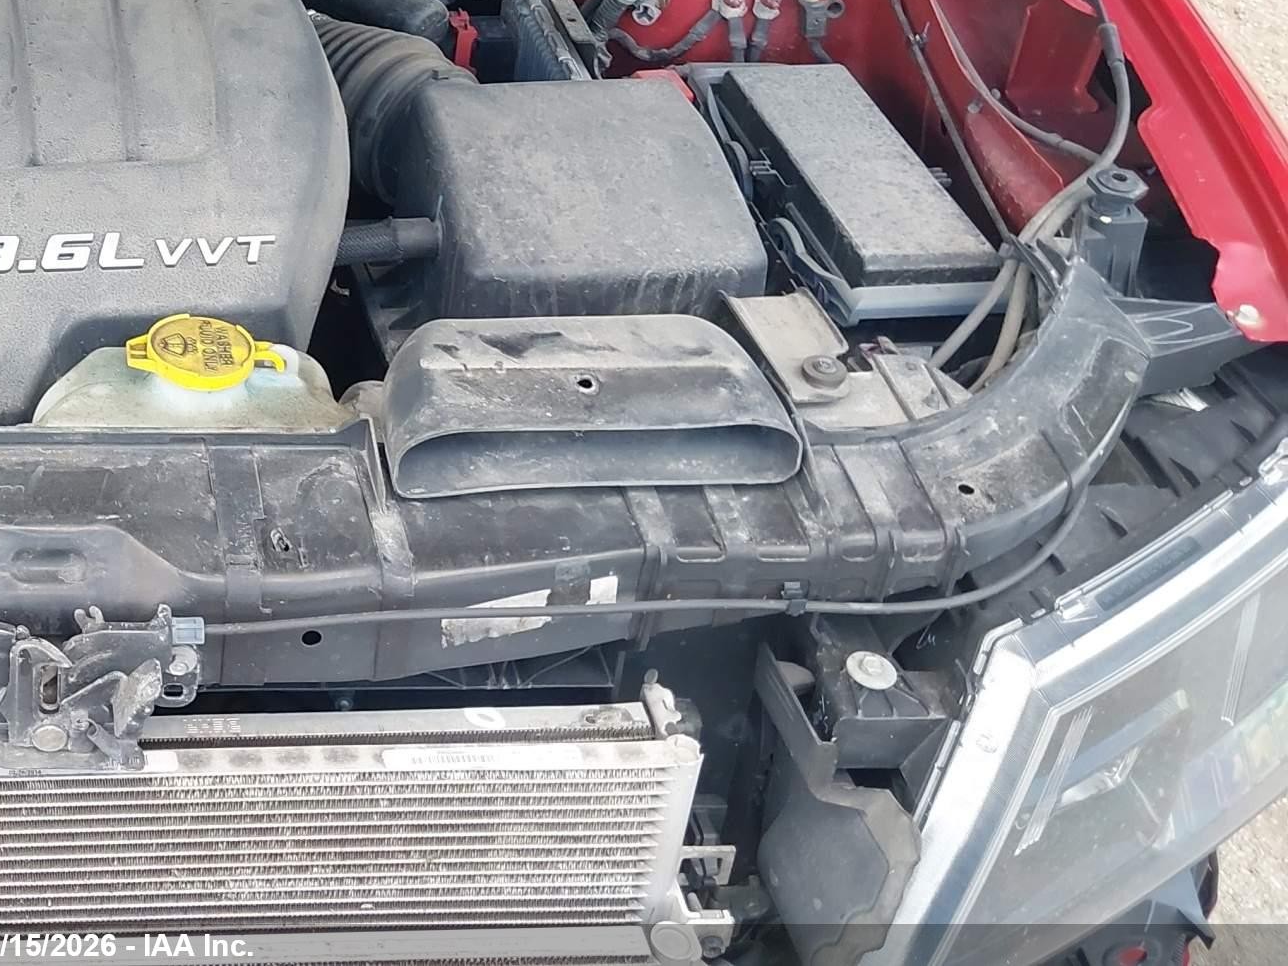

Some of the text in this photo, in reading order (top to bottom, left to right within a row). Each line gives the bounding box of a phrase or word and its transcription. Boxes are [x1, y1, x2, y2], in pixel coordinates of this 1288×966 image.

[155, 235, 276, 268] VVT
[199, 319, 218, 372] FLUID ONLY
[215, 326, 235, 367] WASHER
